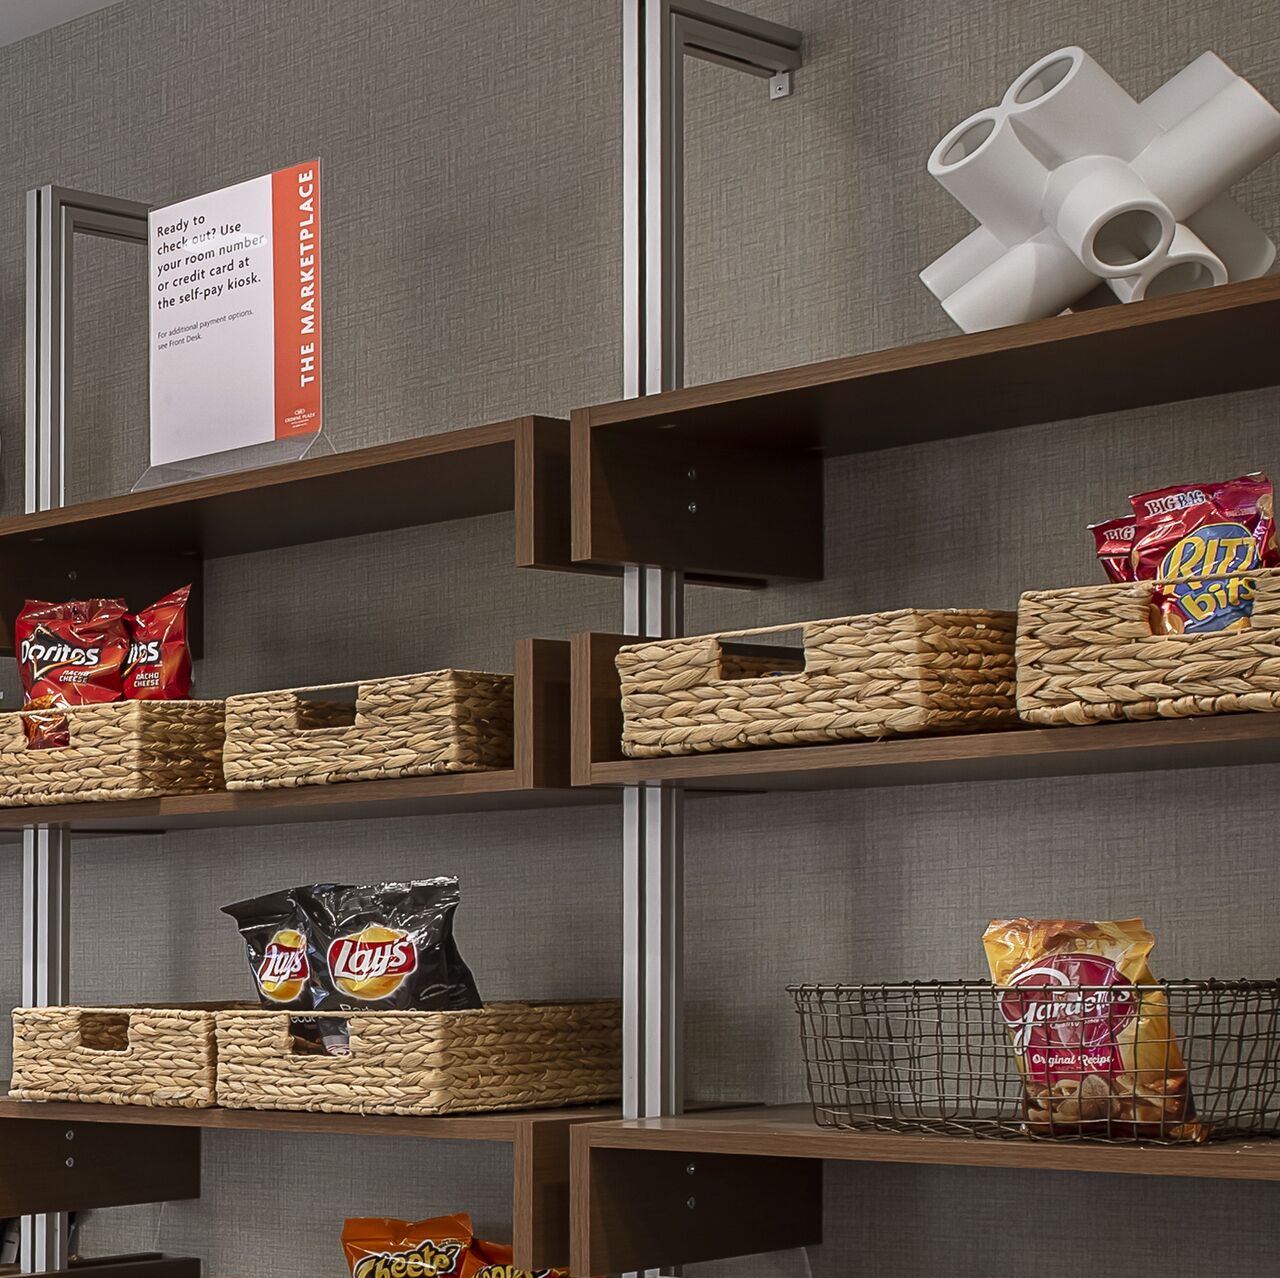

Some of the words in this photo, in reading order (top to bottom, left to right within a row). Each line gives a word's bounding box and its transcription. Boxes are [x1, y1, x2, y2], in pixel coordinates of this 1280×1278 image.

[157, 218, 189, 238] Ready
[193, 215, 205, 226] to
[157, 236, 188, 256] check
[192, 228, 216, 244] out?
[220, 224, 241, 236] Use
[157, 259, 181, 276] your
[185, 249, 215, 265] room
[219, 235, 264, 256] number
[298, 169, 315, 335] MARKETPLACE
[157, 281, 169, 292] or
[173, 270, 206, 288] credit
[209, 260, 234, 276] card
[238, 257, 249, 268] at
[158, 297, 175, 309] the
[179, 284, 224, 304] self-pay
[227, 272, 261, 291] kiosk.
[169, 322, 199, 336] additional
[199, 316, 226, 329] payment
[169, 338, 184, 348] Front
[300, 342, 315, 388] THE
[1145, 499, 1176, 516] BIG
[1177, 490, 1206, 507] BAG
[1104, 526, 1135, 541] BIG
[1181, 577, 1254, 621] bits
[22, 640, 99, 666] Doritos
[133, 679, 159, 688] CHEESE
[261, 944, 303, 982] Lay's
[334, 941, 408, 981] Lay's
[1032, 1054, 1075, 1067] Orginal
